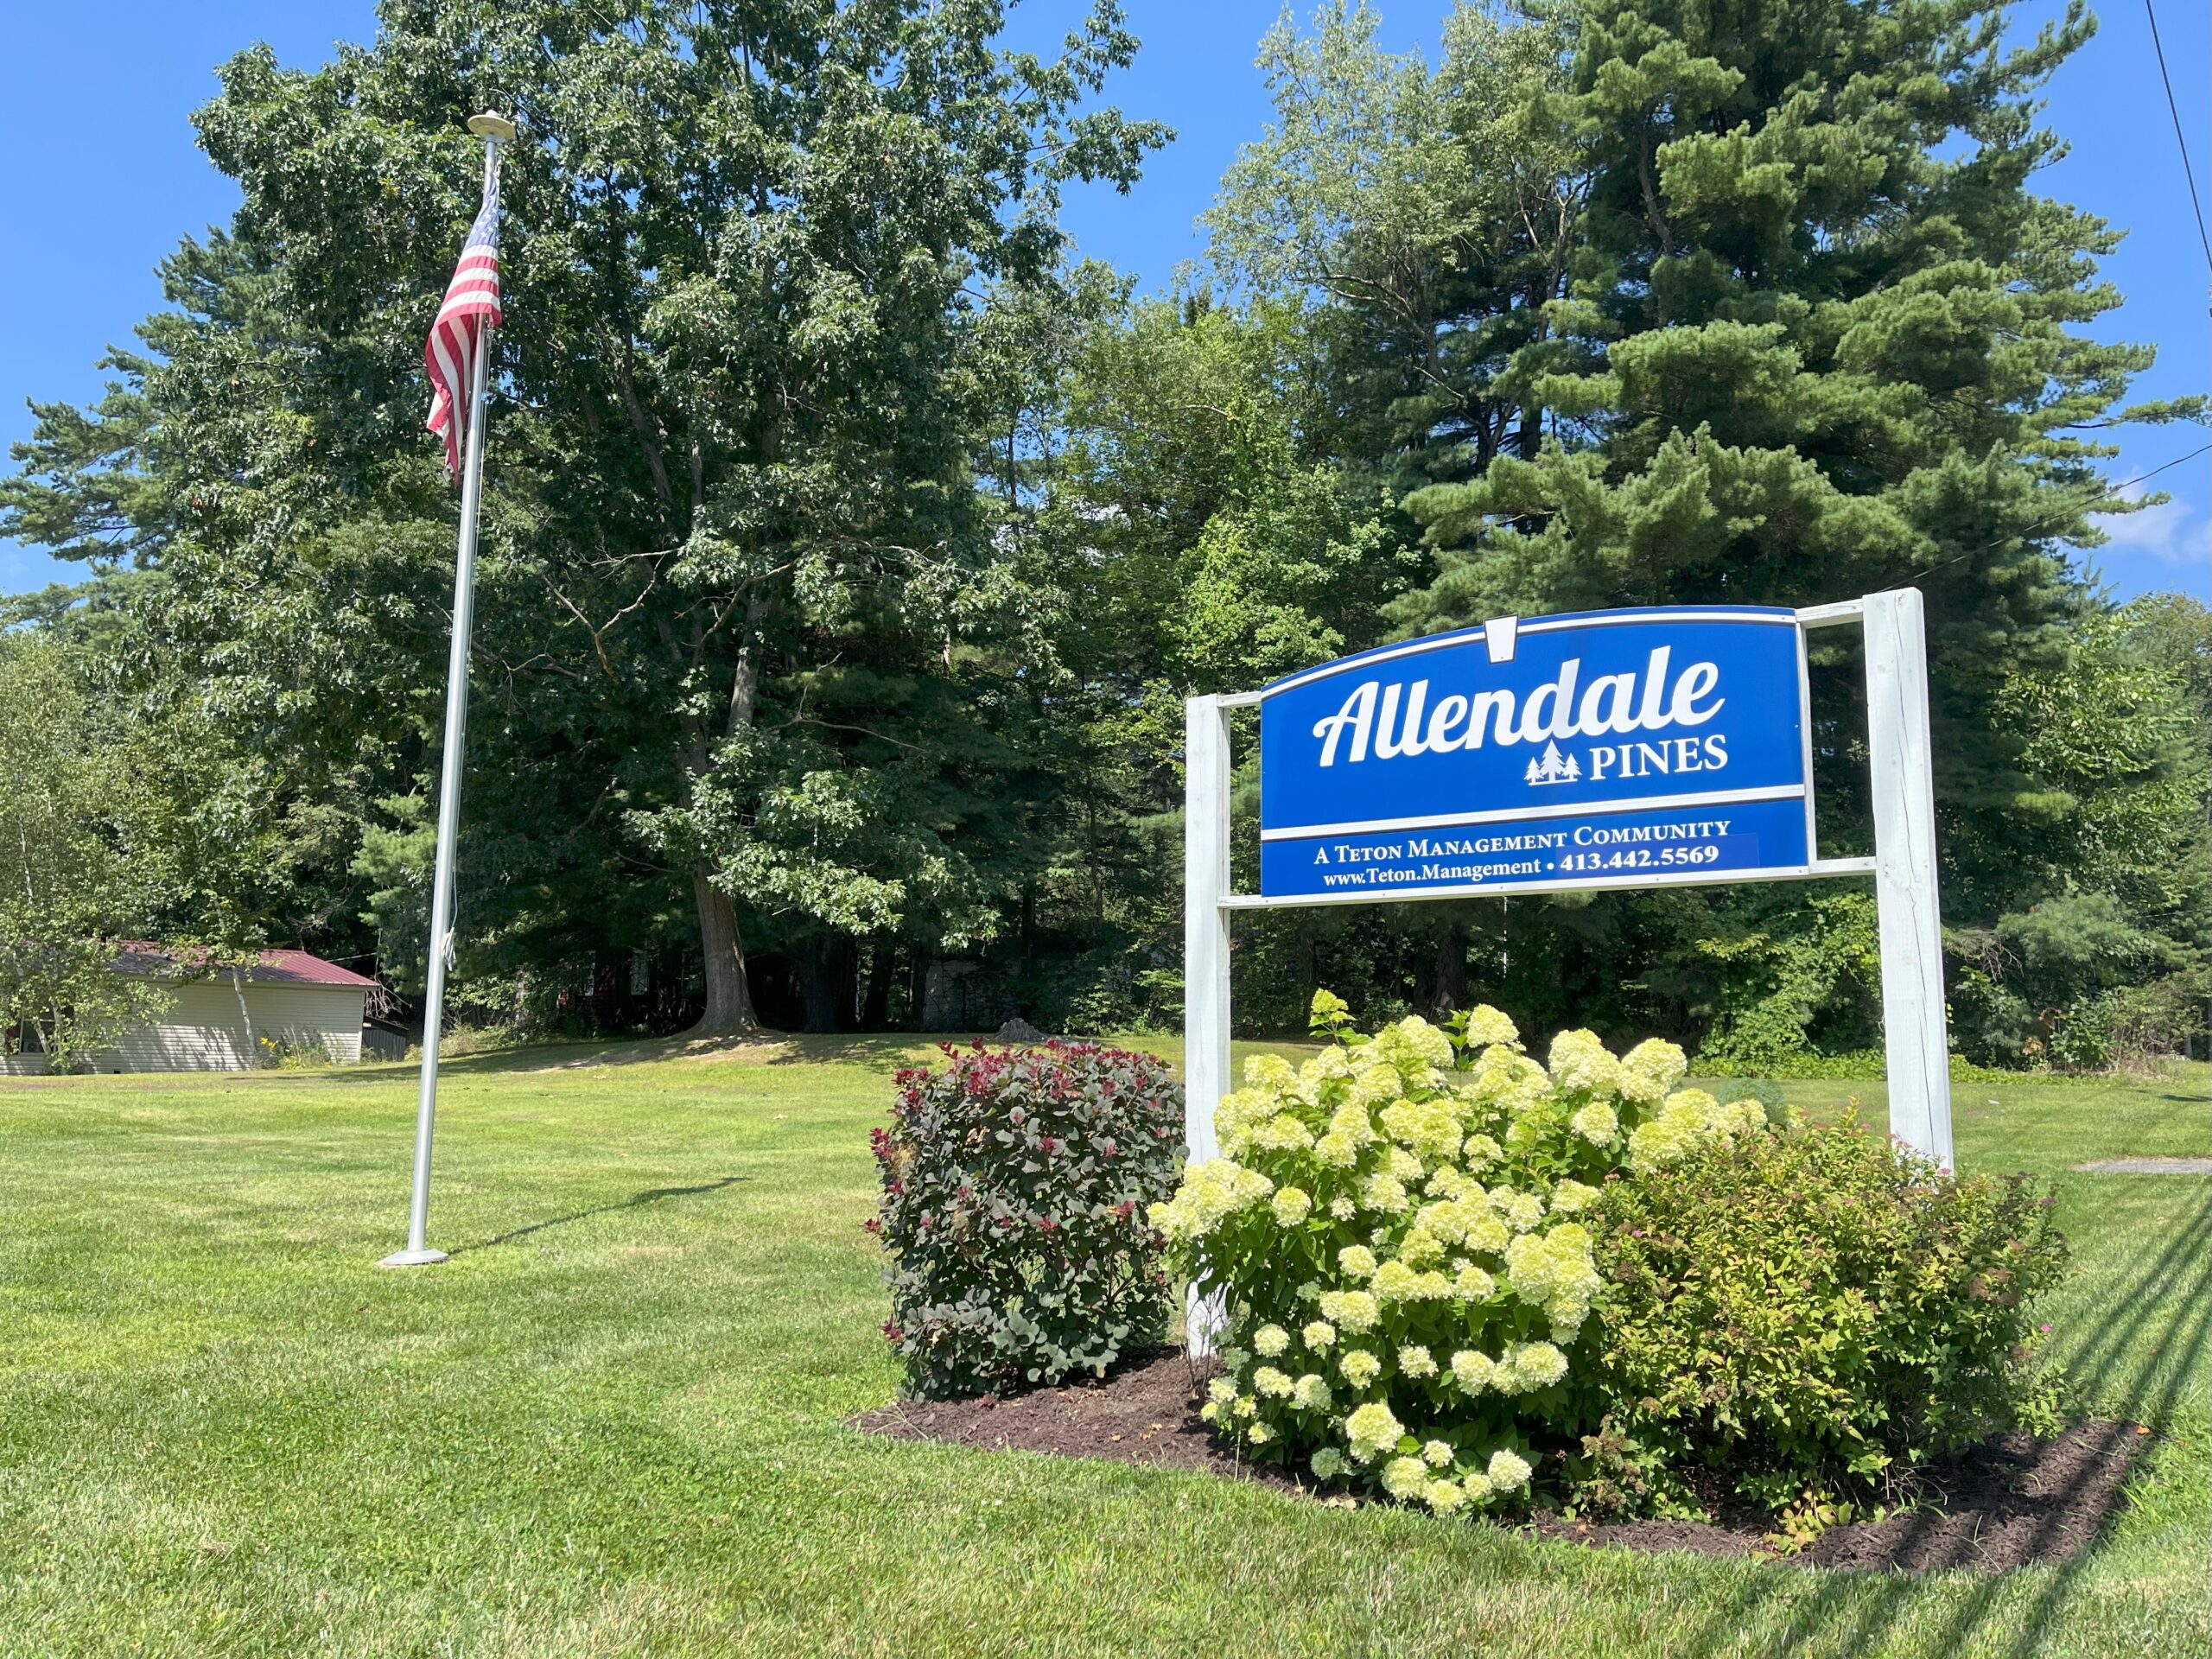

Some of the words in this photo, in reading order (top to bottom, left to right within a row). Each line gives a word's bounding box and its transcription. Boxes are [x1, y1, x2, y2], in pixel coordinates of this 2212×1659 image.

[1313, 645, 1726, 767] Allendale
[1589, 734, 1728, 781] PINES
[1313, 847, 1330, 865] A
[1324, 858, 1541, 887] www.Teton.Management
[1560, 845, 1719, 871] 413.442.5569
